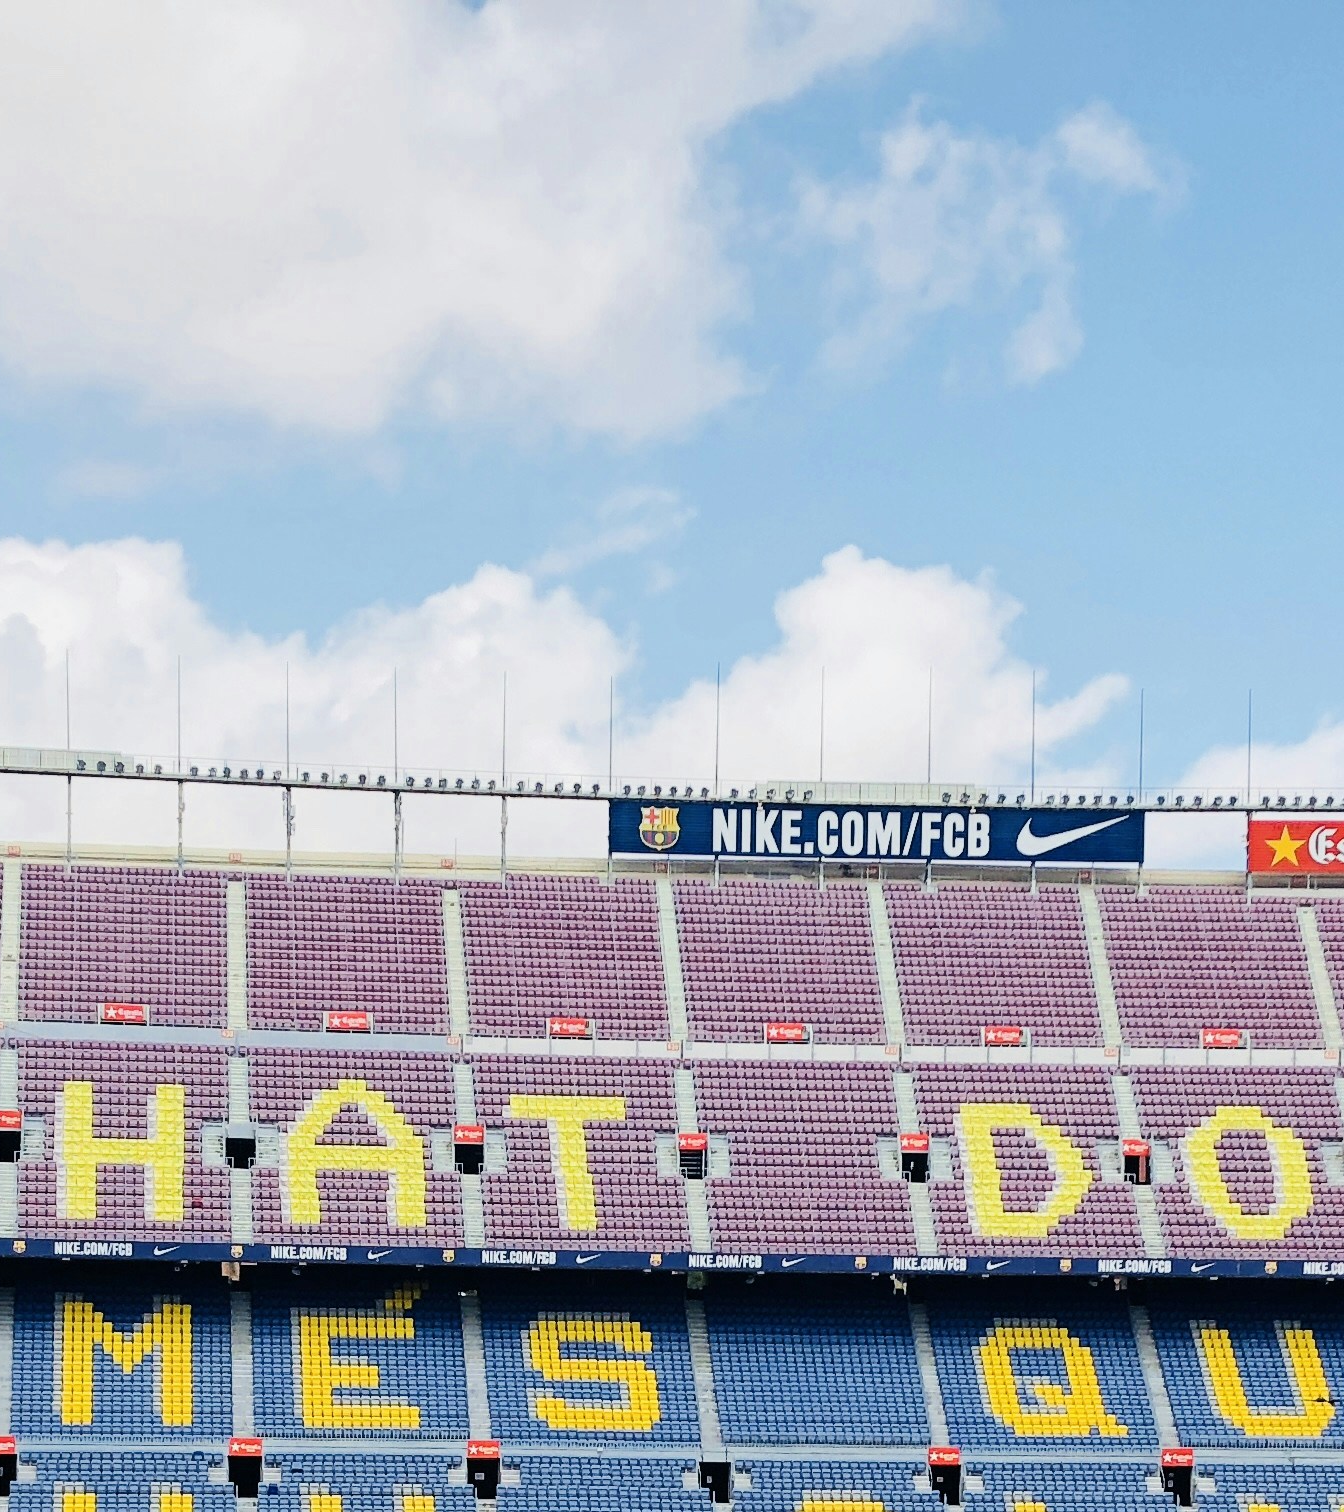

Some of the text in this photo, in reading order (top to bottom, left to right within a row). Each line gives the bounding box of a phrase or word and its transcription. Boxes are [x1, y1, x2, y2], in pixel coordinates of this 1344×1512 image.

[711, 808, 991, 857] NIKE.COM/FCB
[54, 1241, 133, 1256] NIKE.COM/FCB
[271, 1246, 347, 1260] NIKE.COM/FCB
[481, 1250, 557, 1264] NIKE.COM/FCB
[688, 1254, 762, 1269] NIKE.COM/FCB
[893, 1257, 967, 1272] NIKE.COM/FCB
[1098, 1259, 1172, 1273] NIKE.COM/FCB
